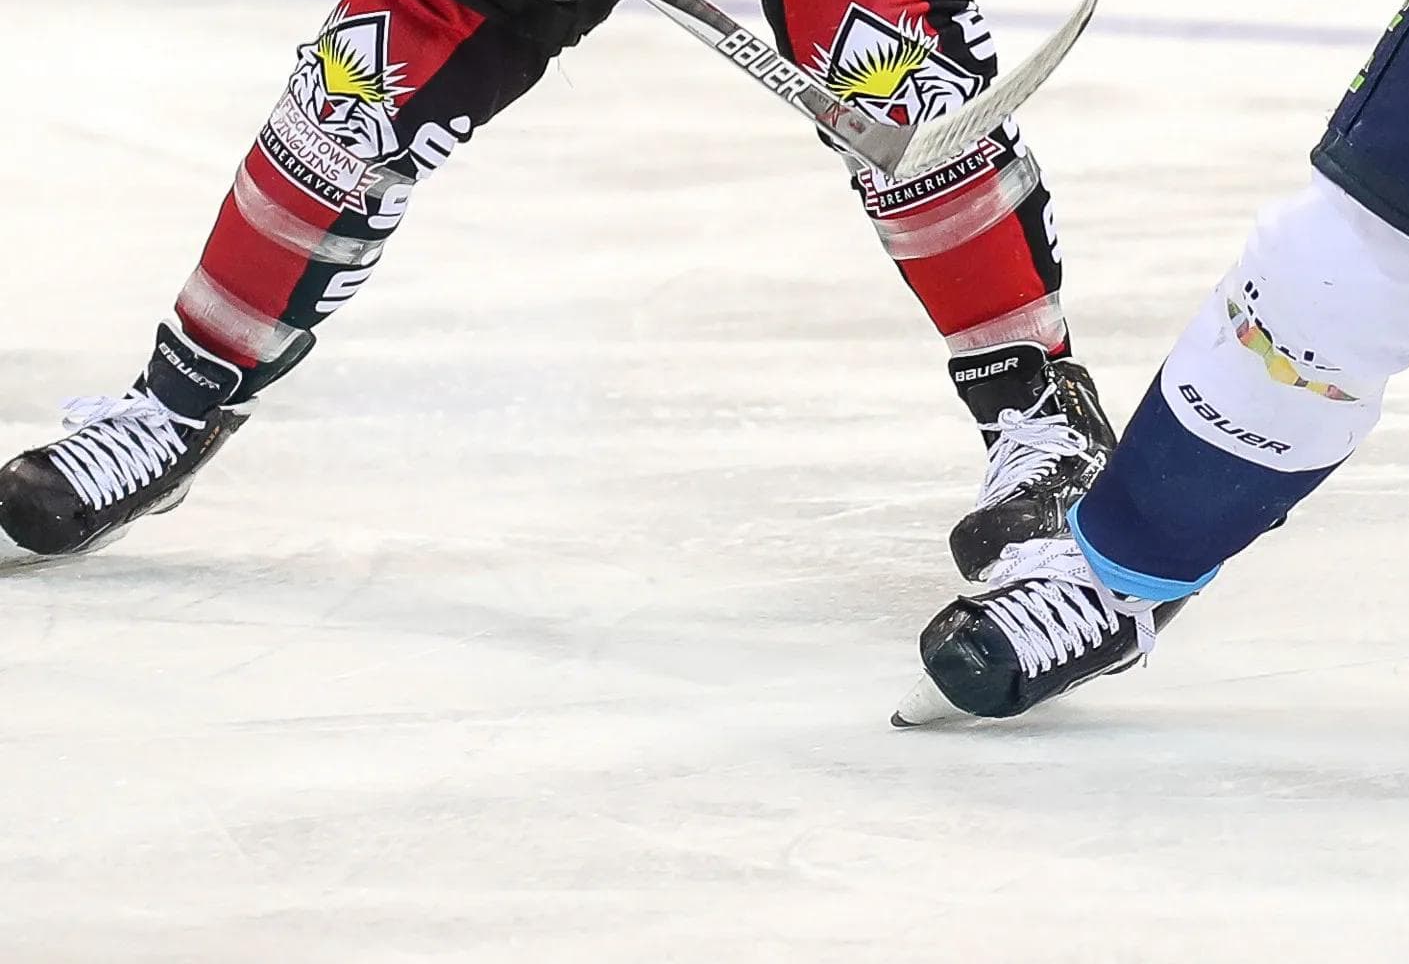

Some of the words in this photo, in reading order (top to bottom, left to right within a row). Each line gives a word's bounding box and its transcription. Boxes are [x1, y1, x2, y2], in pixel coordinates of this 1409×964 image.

[715, 28, 811, 107] BAUER
[879, 152, 986, 209] BREMERHAVEN
[955, 356, 1020, 383] BAUER
[1177, 383, 1292, 456] BAUER
